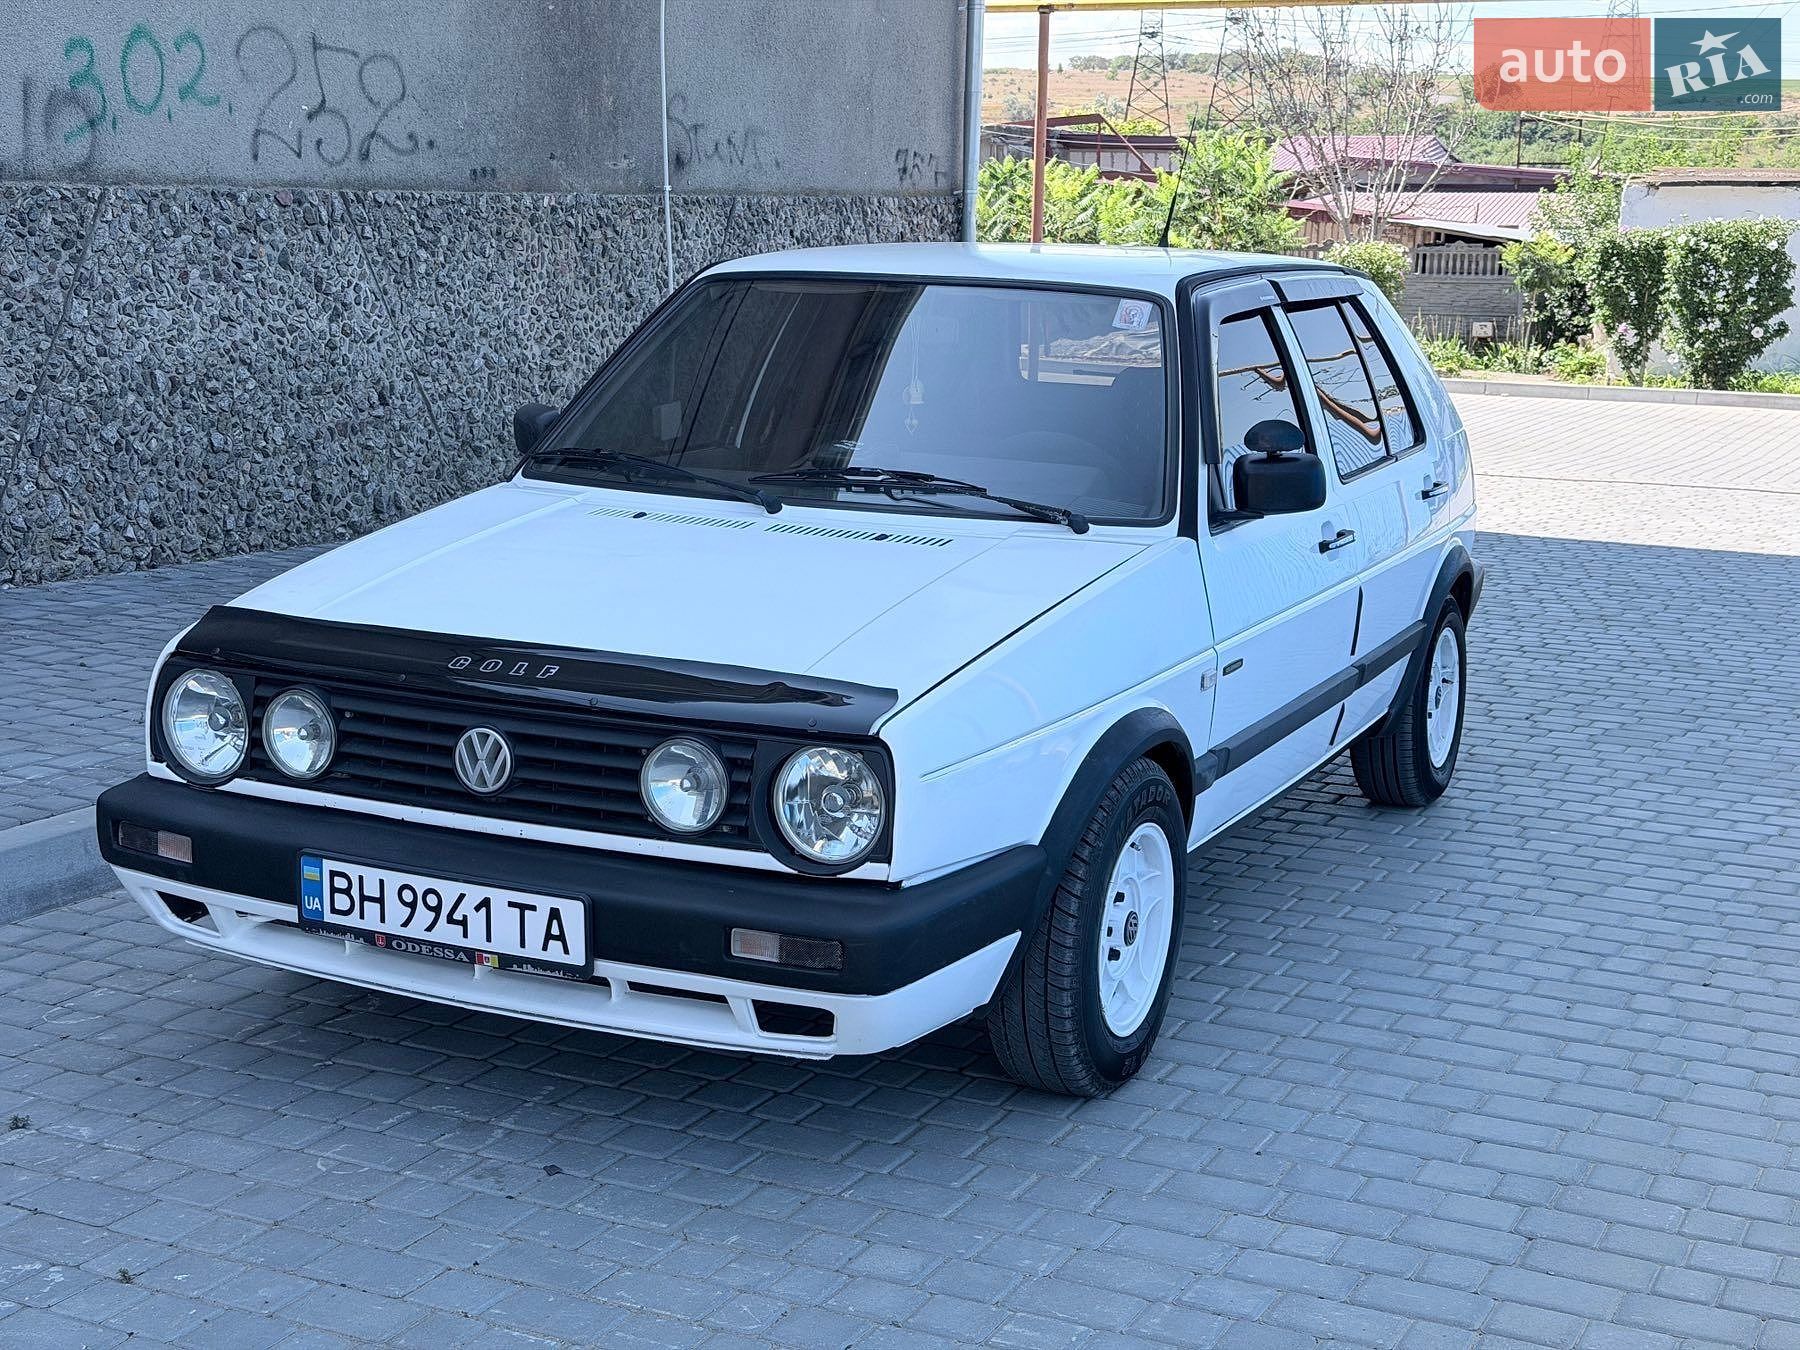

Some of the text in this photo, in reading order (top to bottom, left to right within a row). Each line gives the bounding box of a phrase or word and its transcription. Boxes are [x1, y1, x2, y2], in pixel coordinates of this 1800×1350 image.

[448, 656, 560, 679] GOLF
[304, 895, 322, 912] UA
[329, 869, 570, 955] BH 9941 TA
[391, 938, 470, 963] ODESSA
